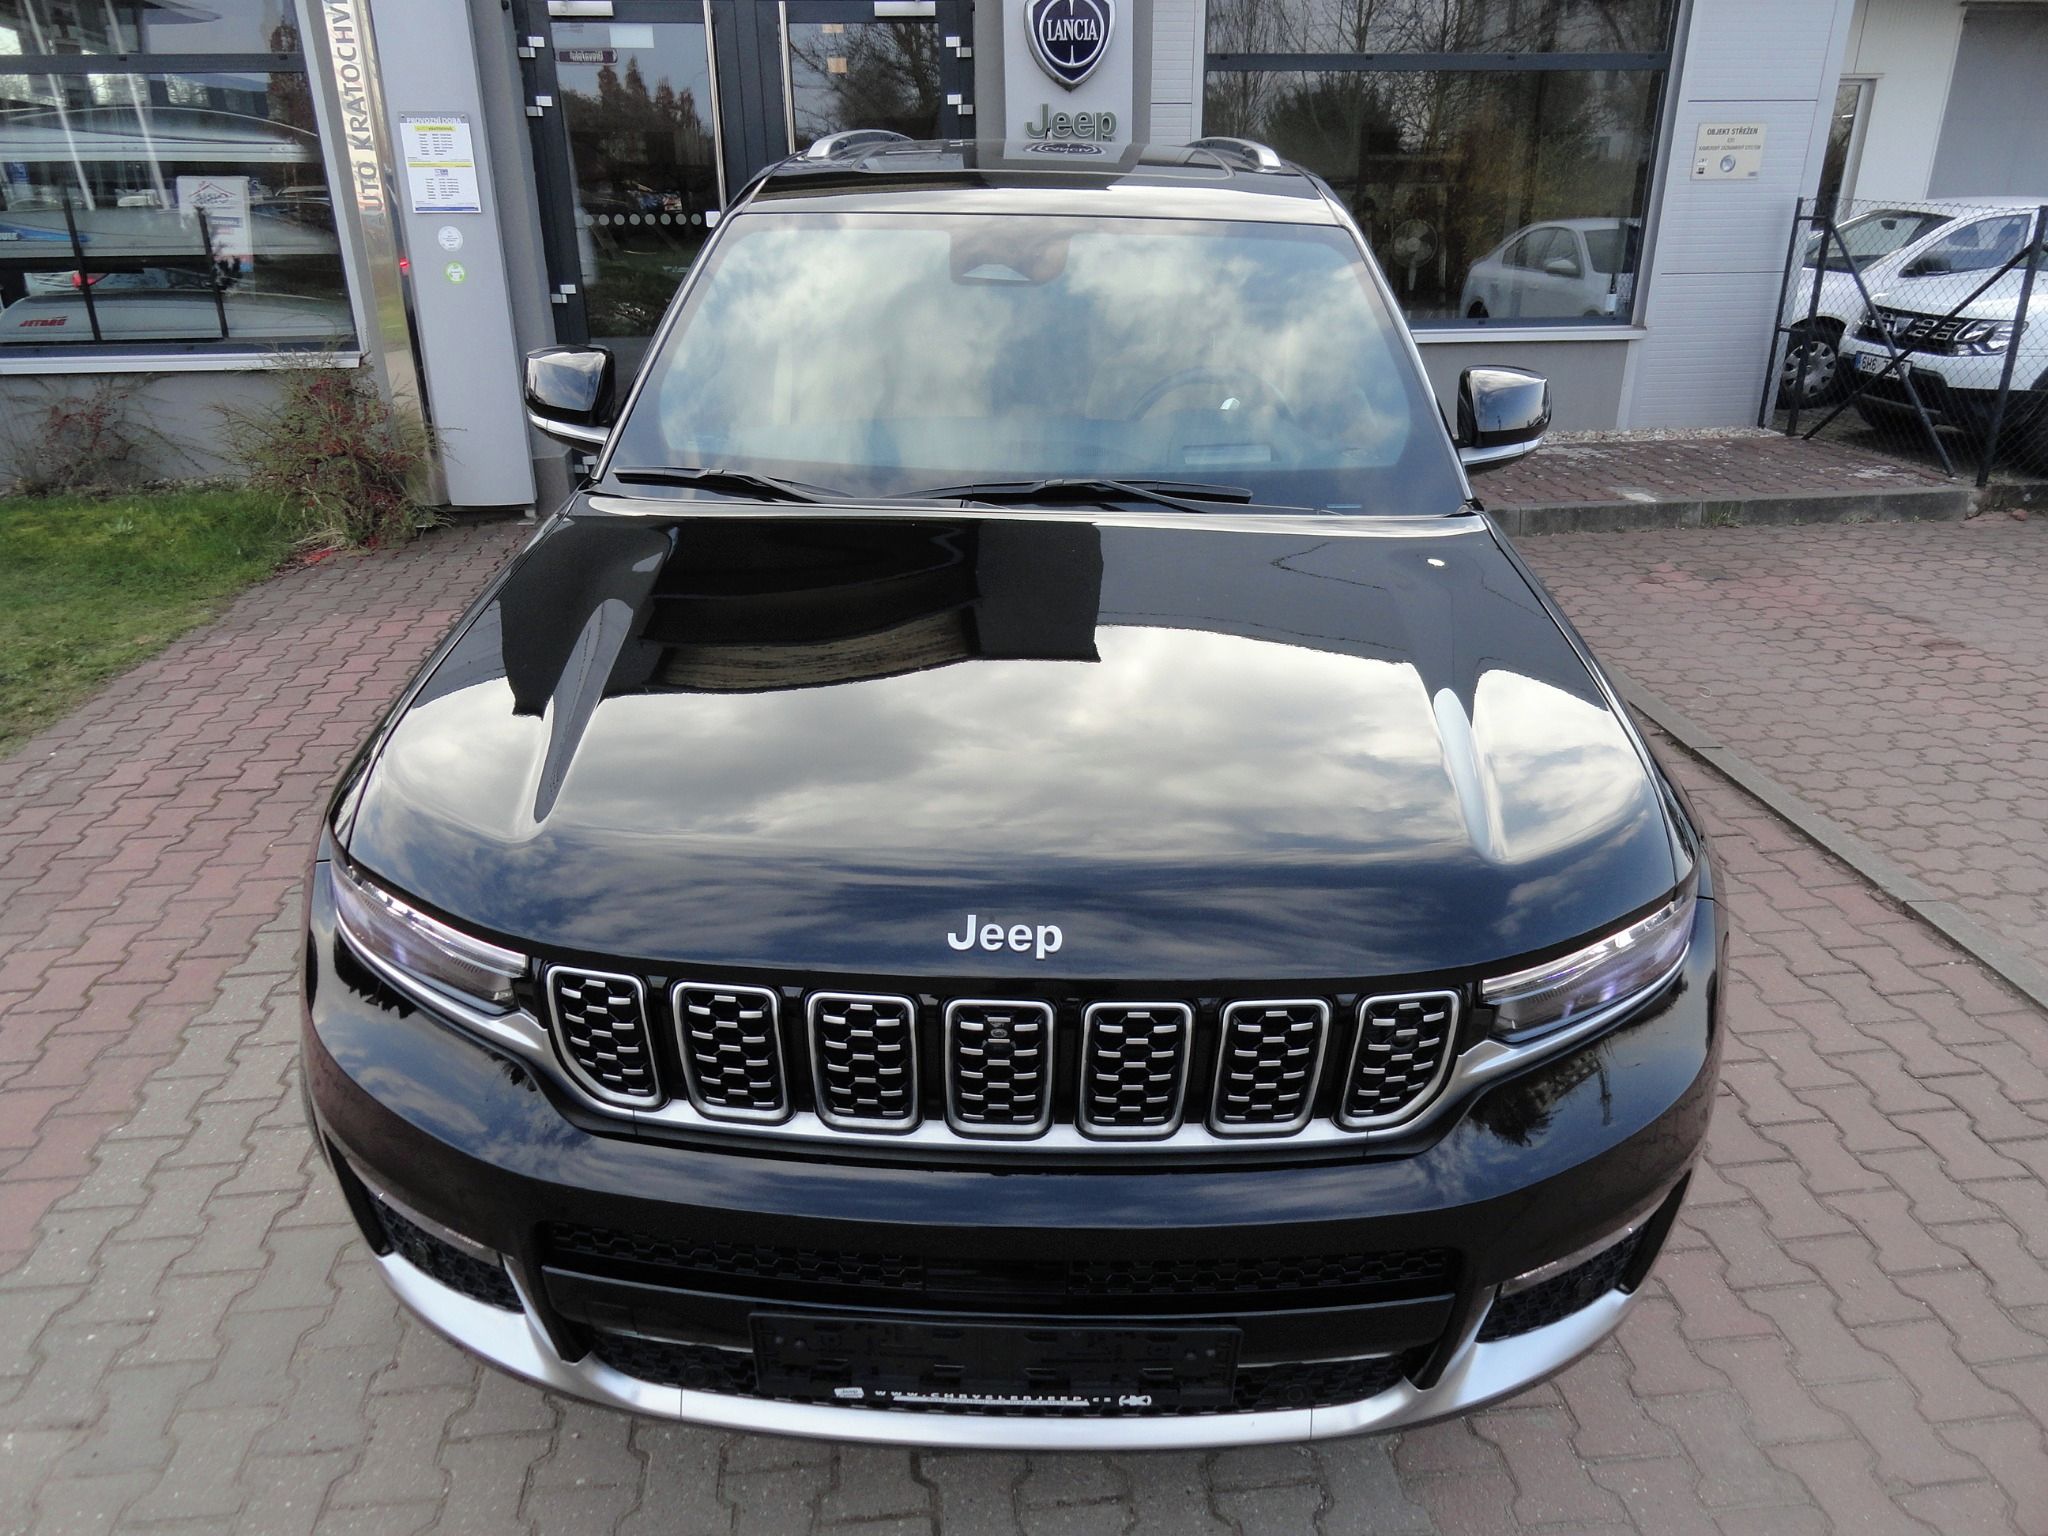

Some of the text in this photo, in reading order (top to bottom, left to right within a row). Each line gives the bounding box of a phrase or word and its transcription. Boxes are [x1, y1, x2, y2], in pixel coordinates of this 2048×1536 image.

[1047, 19, 1099, 41] LANCIA
[1024, 103, 1117, 142] Jeep
[1731, 126, 1758, 135] STŘEŽEN
[357, 161, 385, 222] UTO
[947, 914, 1063, 960] Jeep
